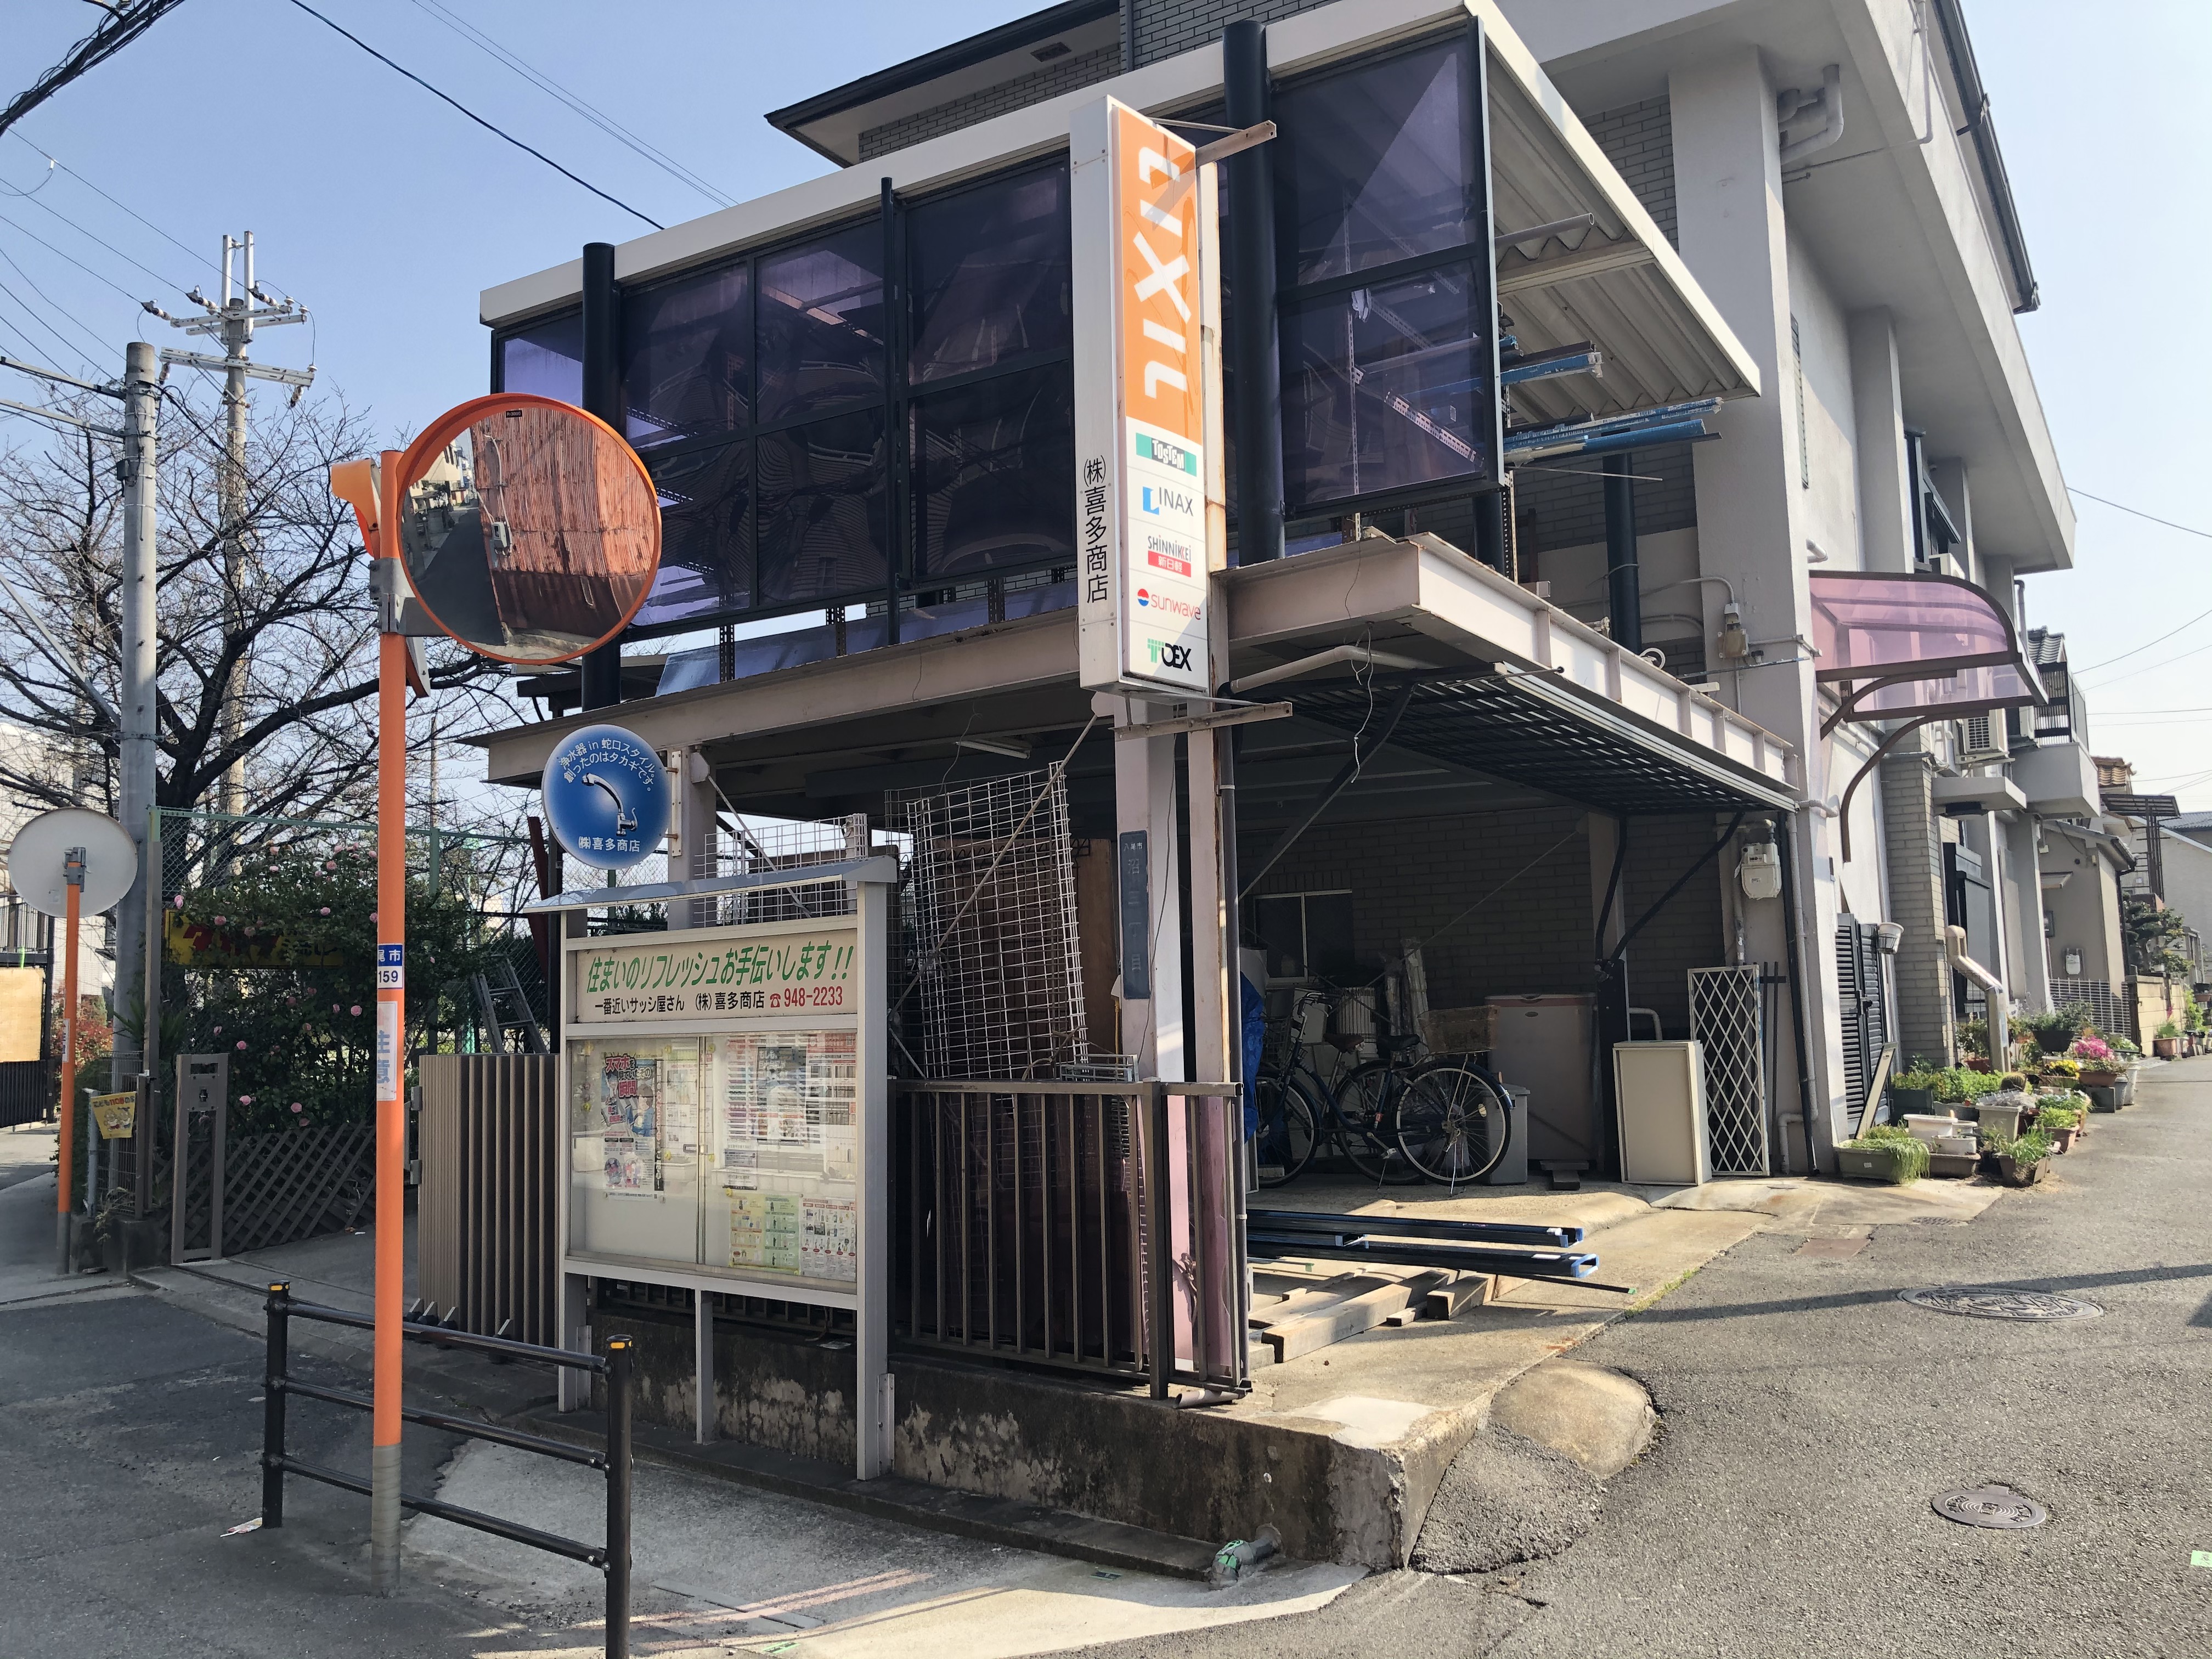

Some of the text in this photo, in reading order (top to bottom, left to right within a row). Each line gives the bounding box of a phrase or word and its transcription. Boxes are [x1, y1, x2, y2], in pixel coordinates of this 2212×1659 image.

[1133, 146, 1191, 399] LIXIL
[1153, 440, 1184, 469] TOSTEM
[1159, 487, 1194, 517] INAX
[1158, 555, 1183, 573] 新日軽
[1150, 594, 1201, 620] sunwave
[1147, 638, 1192, 672] TOEX
[595, 994, 685, 1016] 一番近いサッシ屋さん
[784, 985, 843, 1008] 948-2233
[605, 1054, 635, 1073] スマホを
